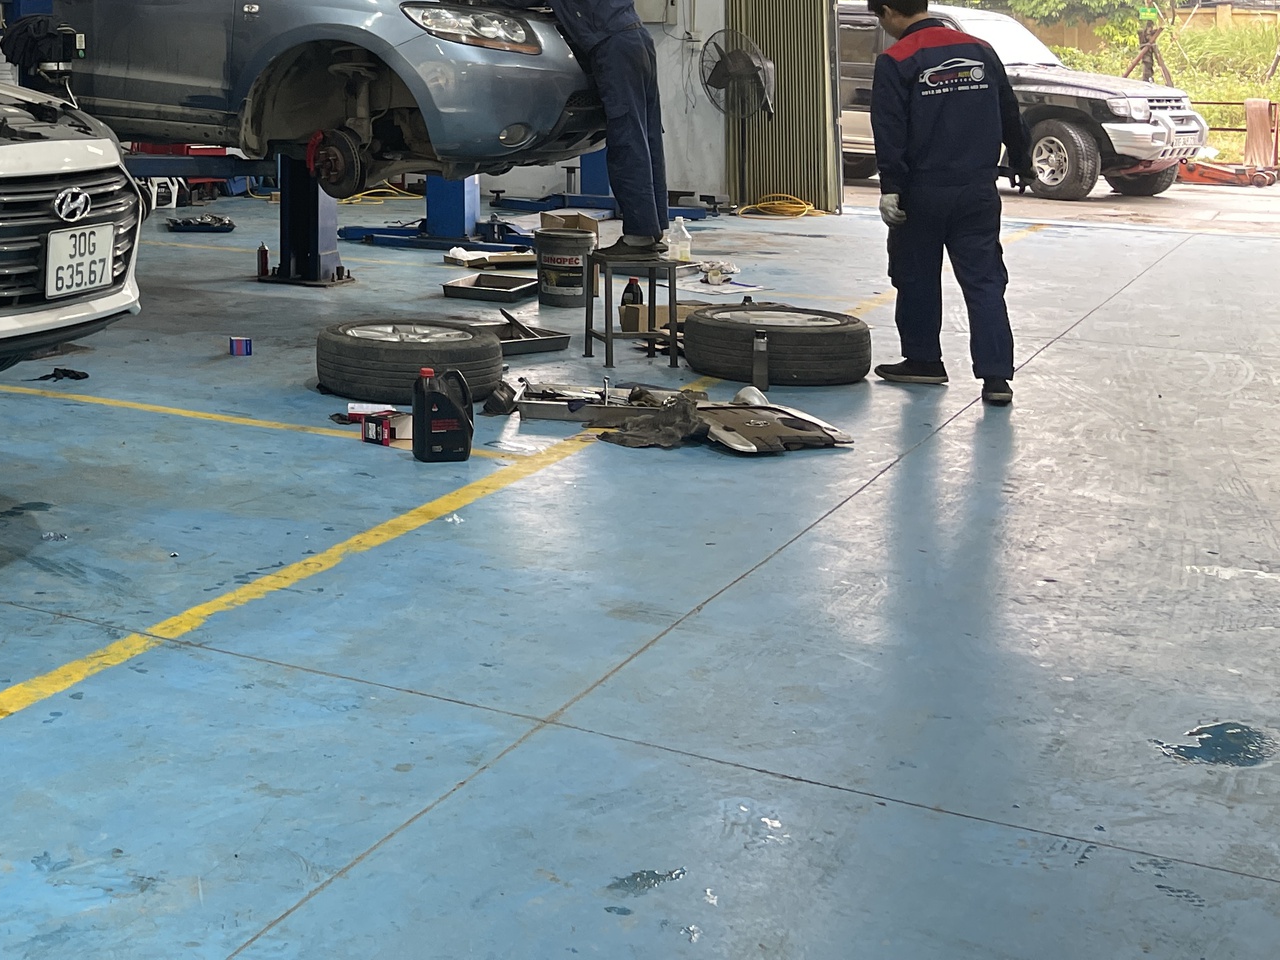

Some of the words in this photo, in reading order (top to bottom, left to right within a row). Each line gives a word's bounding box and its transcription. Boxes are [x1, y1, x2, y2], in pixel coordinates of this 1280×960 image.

[68, 230, 96, 259] 30G
[543, 255, 580, 265] SINOPEC
[55, 258, 107, 292] 635.67
